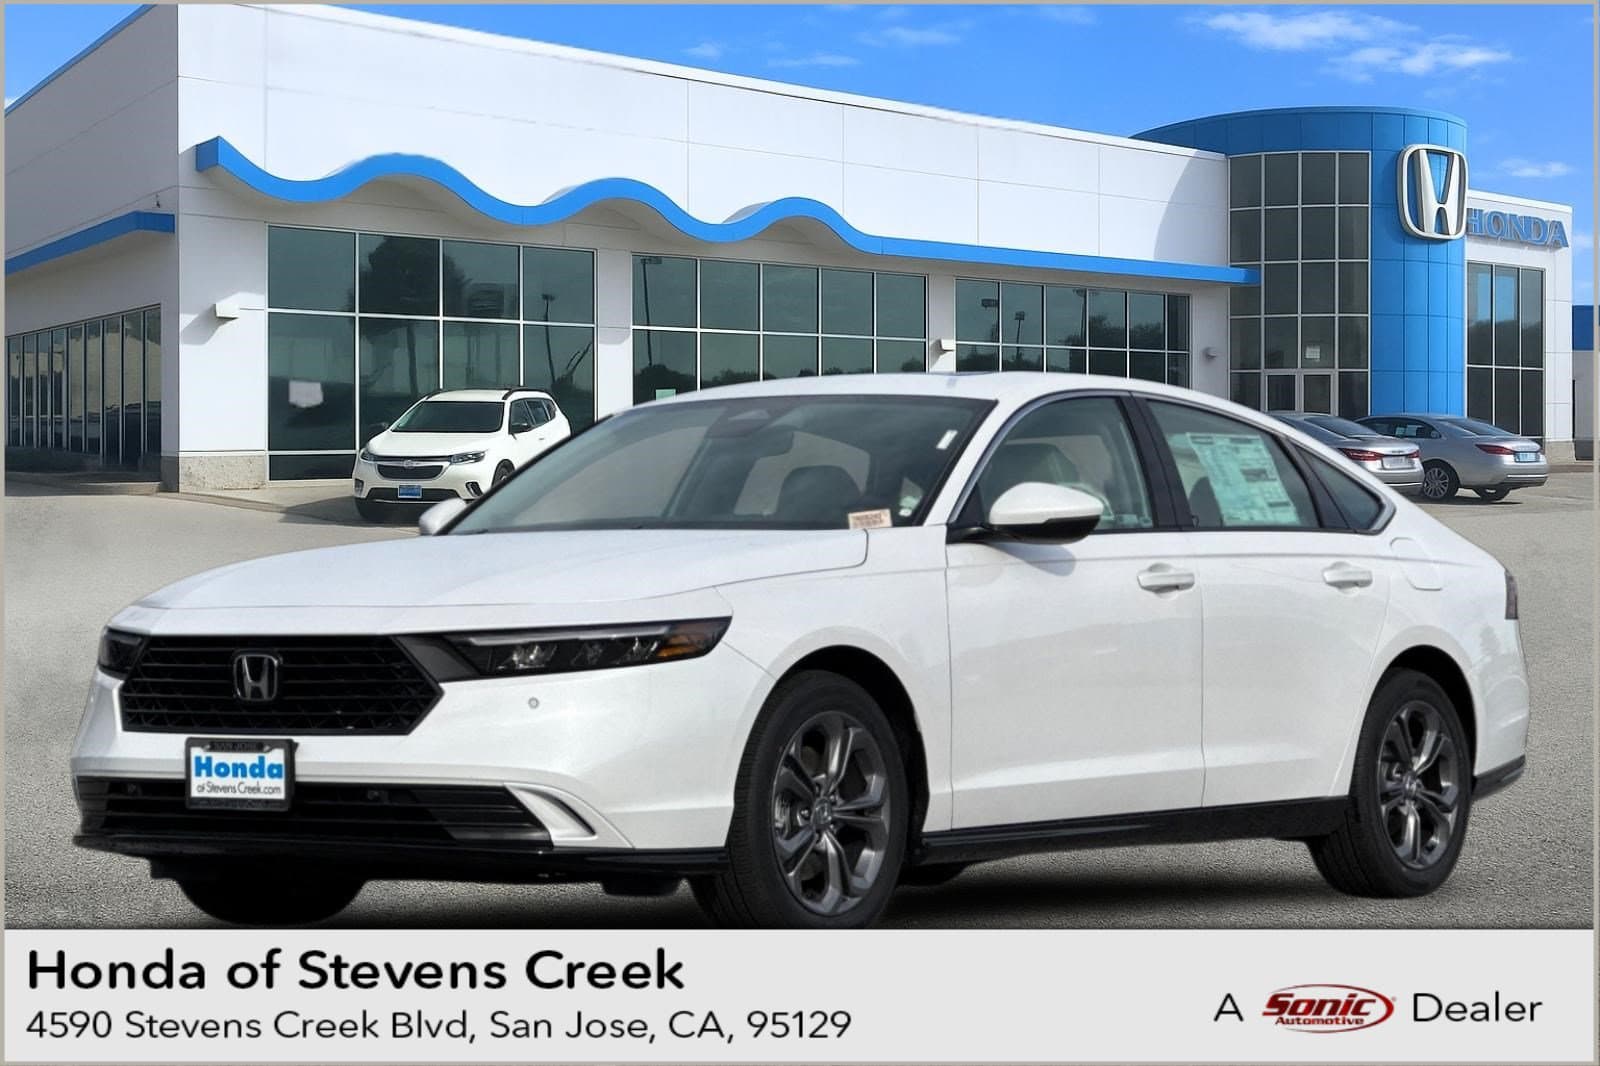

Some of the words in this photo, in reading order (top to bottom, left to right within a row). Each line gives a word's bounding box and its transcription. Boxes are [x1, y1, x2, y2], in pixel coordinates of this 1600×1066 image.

[1467, 207, 1570, 248] HONDA
[194, 755, 283, 779] Honda
[196, 783, 206, 793] of
[206, 781, 237, 794] Stevens
